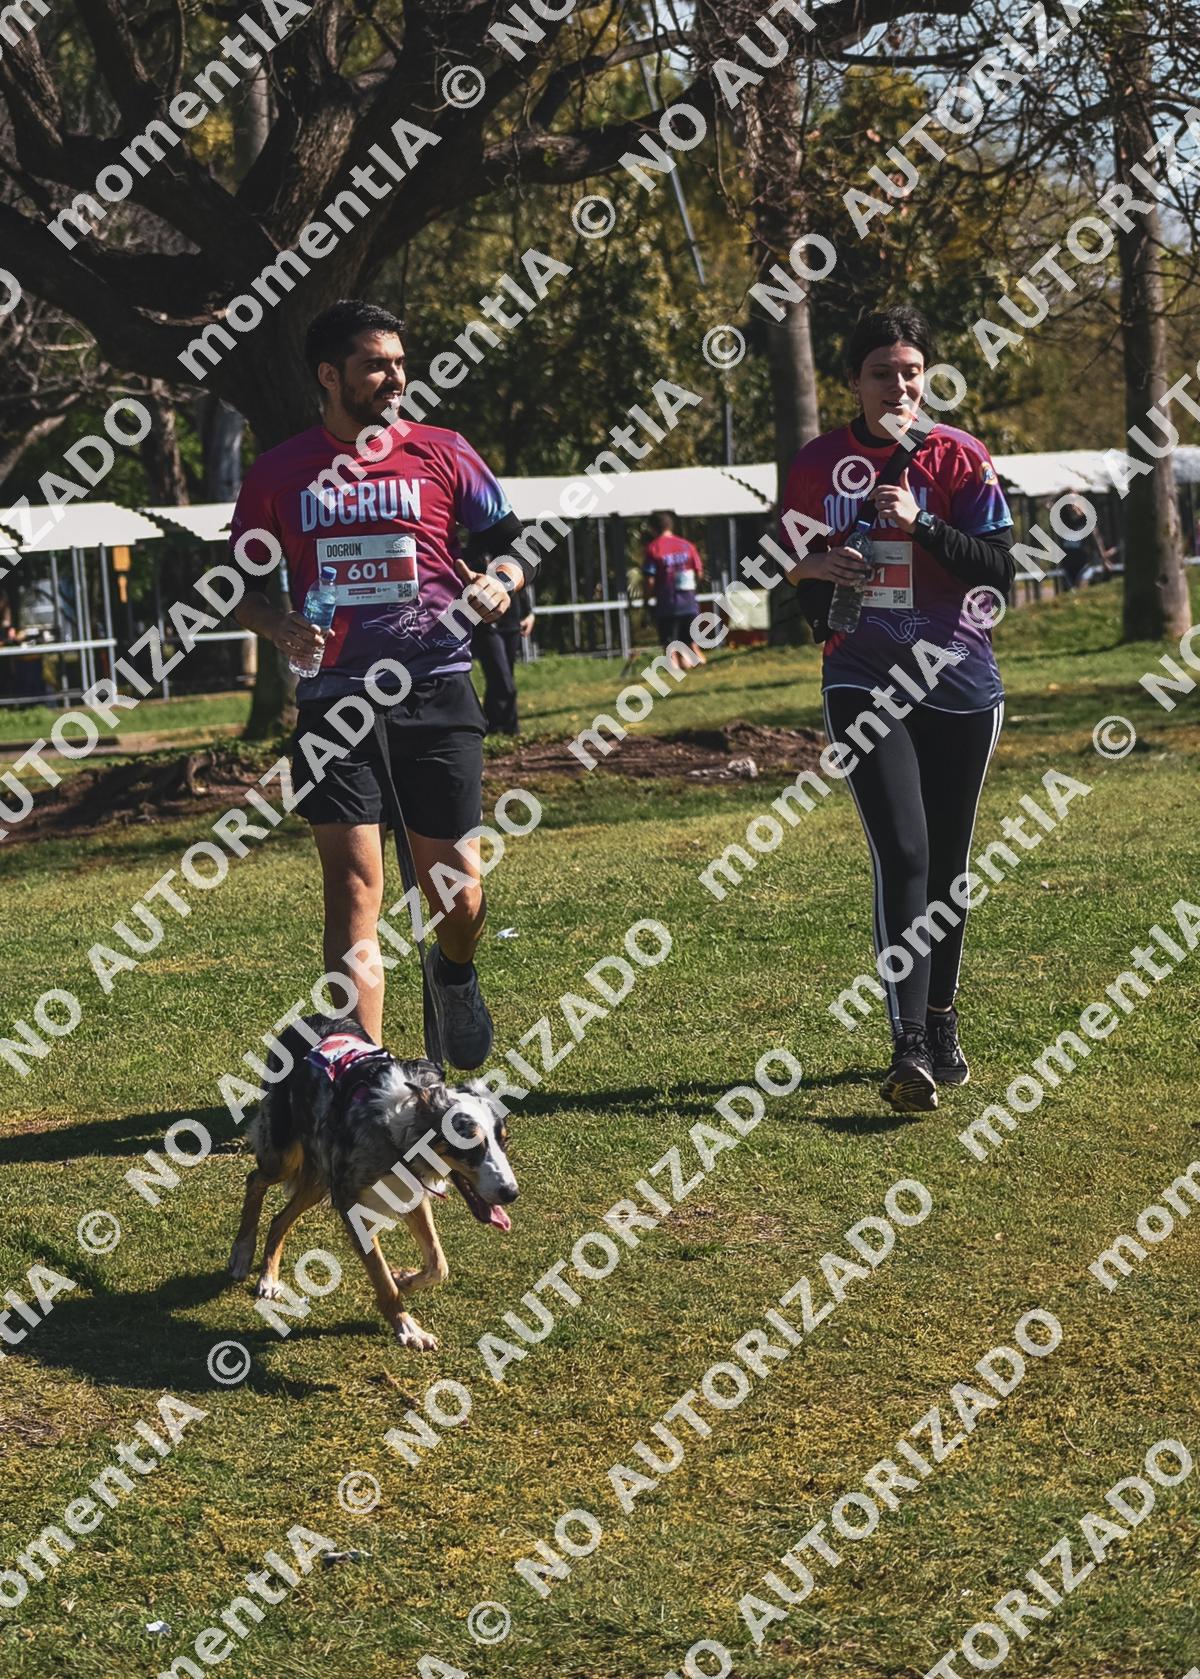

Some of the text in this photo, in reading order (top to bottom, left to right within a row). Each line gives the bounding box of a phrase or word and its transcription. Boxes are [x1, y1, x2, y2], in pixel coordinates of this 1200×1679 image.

[300, 479, 421, 532] DOGRUN
[326, 542, 362, 558] DOGRUN
[347, 562, 388, 580] 601
